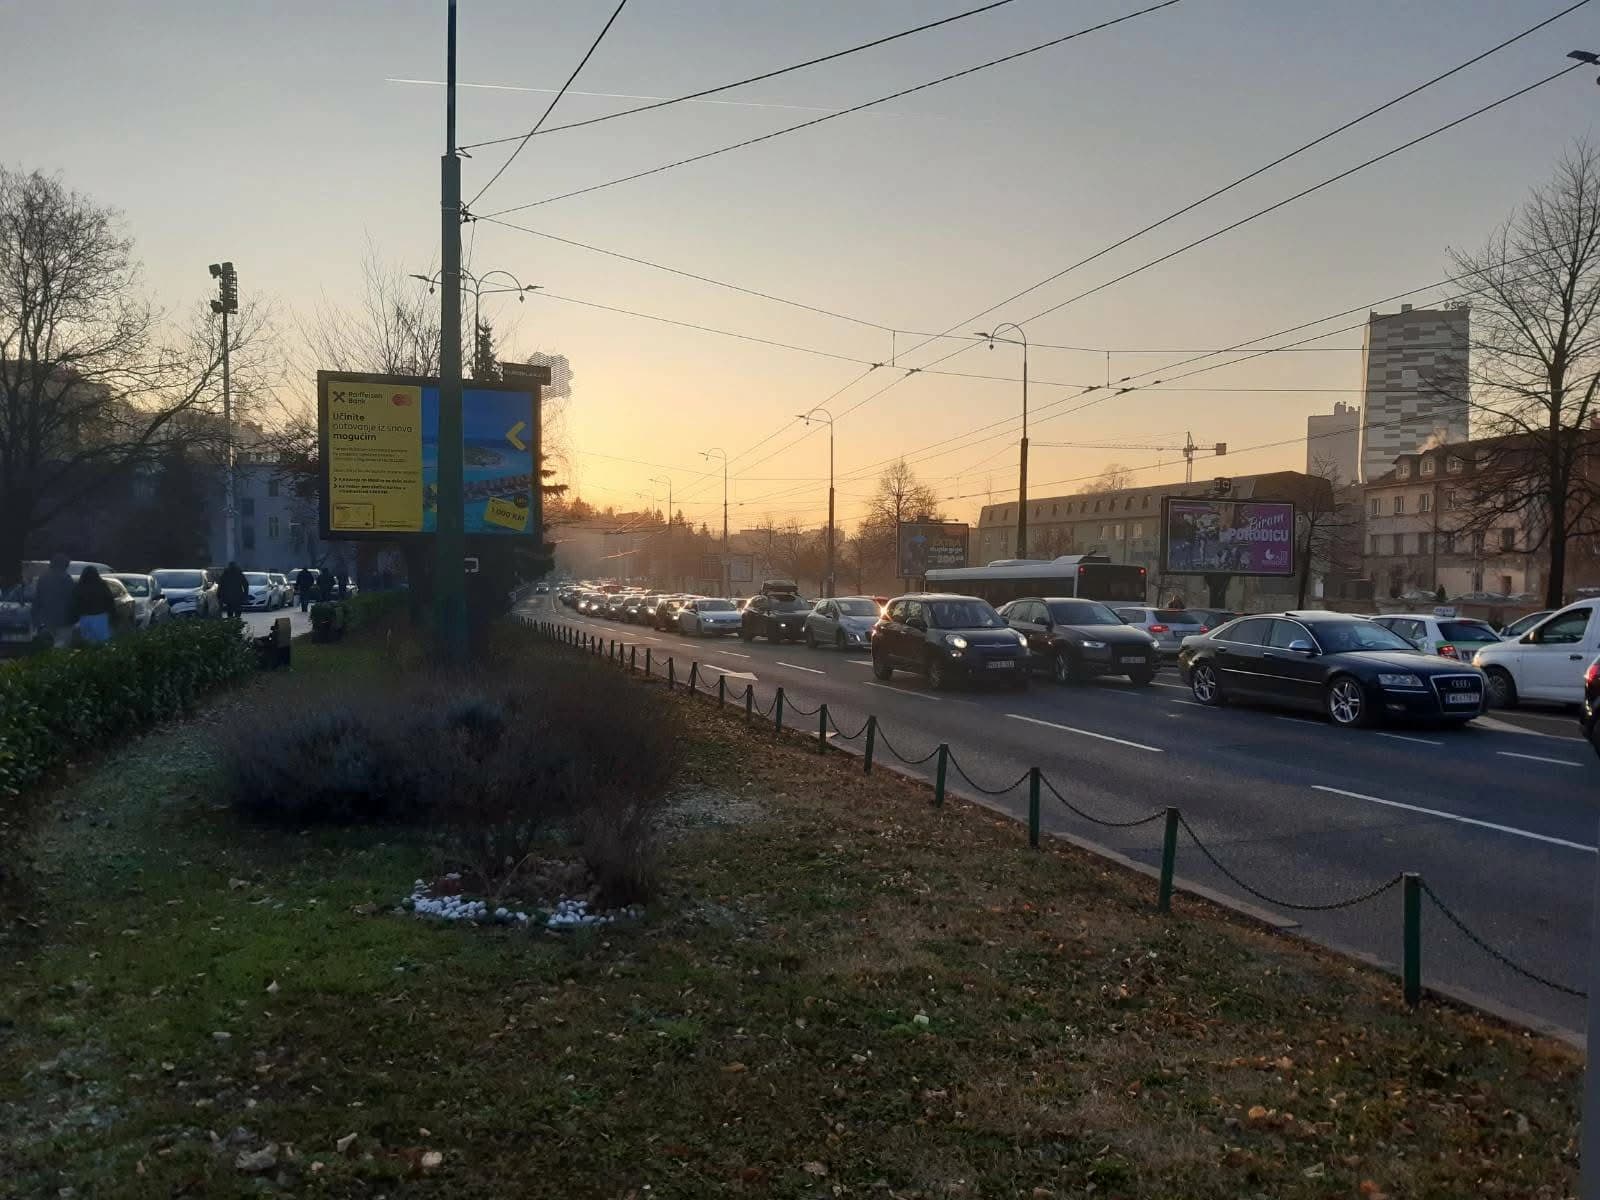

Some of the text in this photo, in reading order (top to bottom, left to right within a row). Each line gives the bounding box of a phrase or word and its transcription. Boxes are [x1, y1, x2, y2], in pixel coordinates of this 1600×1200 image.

[348, 391, 384, 399] Raiffeisen
[333, 412, 365, 421] Učinite
[333, 432, 377, 441] mogućim
[1231, 529, 1289, 542] PORODICU
